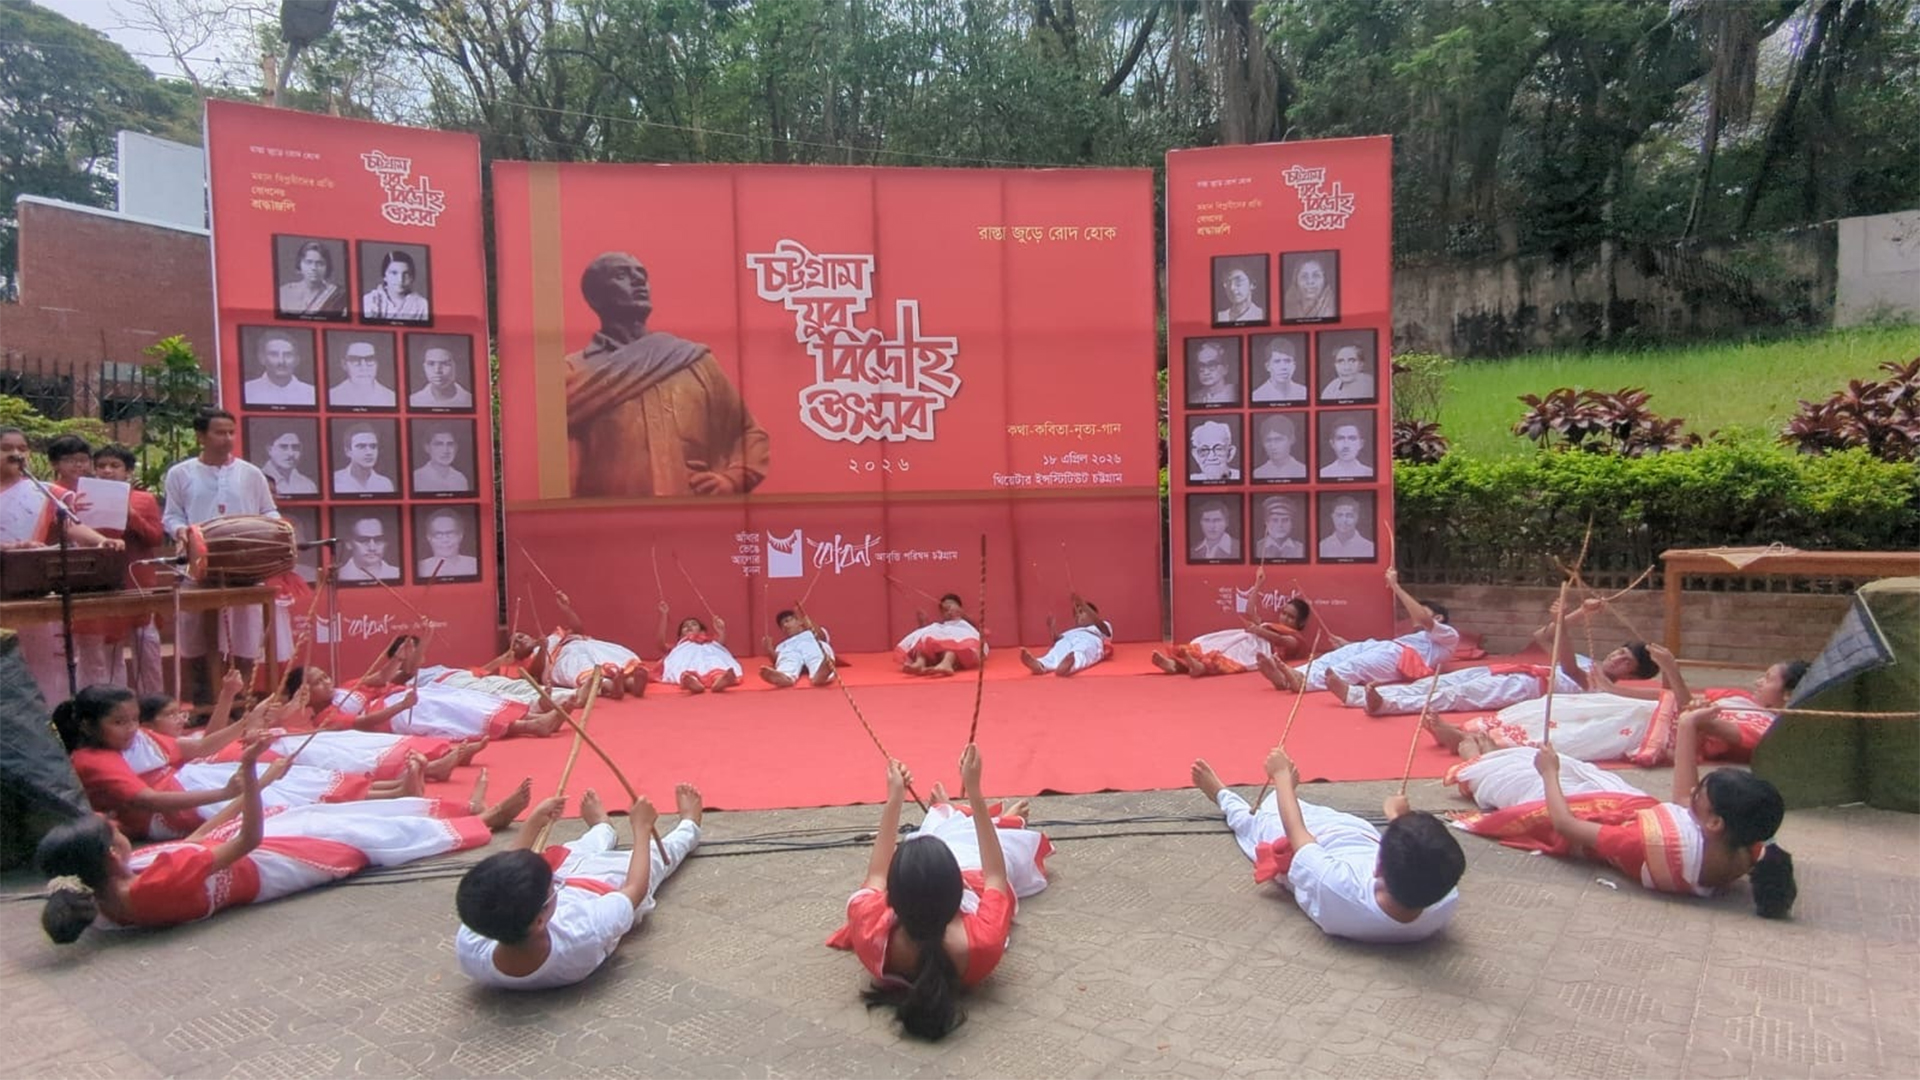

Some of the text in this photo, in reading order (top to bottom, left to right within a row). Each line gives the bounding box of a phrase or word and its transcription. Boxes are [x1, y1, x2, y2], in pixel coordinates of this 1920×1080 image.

[978, 225, 1117, 244] রাস্তা জুড়ে রোদ হোক
[747, 239, 874, 300] চট্টগ্রাম
[785, 296, 866, 342] যুব
[807, 299, 961, 397] বিদ্রোহ
[799, 385, 945, 443] উৎসব
[849, 459, 909, 474] ২০২৬
[1043, 451, 1121, 465] ১৮ এপ্রিল ২০২৬
[993, 472, 1031, 486] থিয়েটার
[1092, 470, 1123, 484] চট্টগ্রাম
